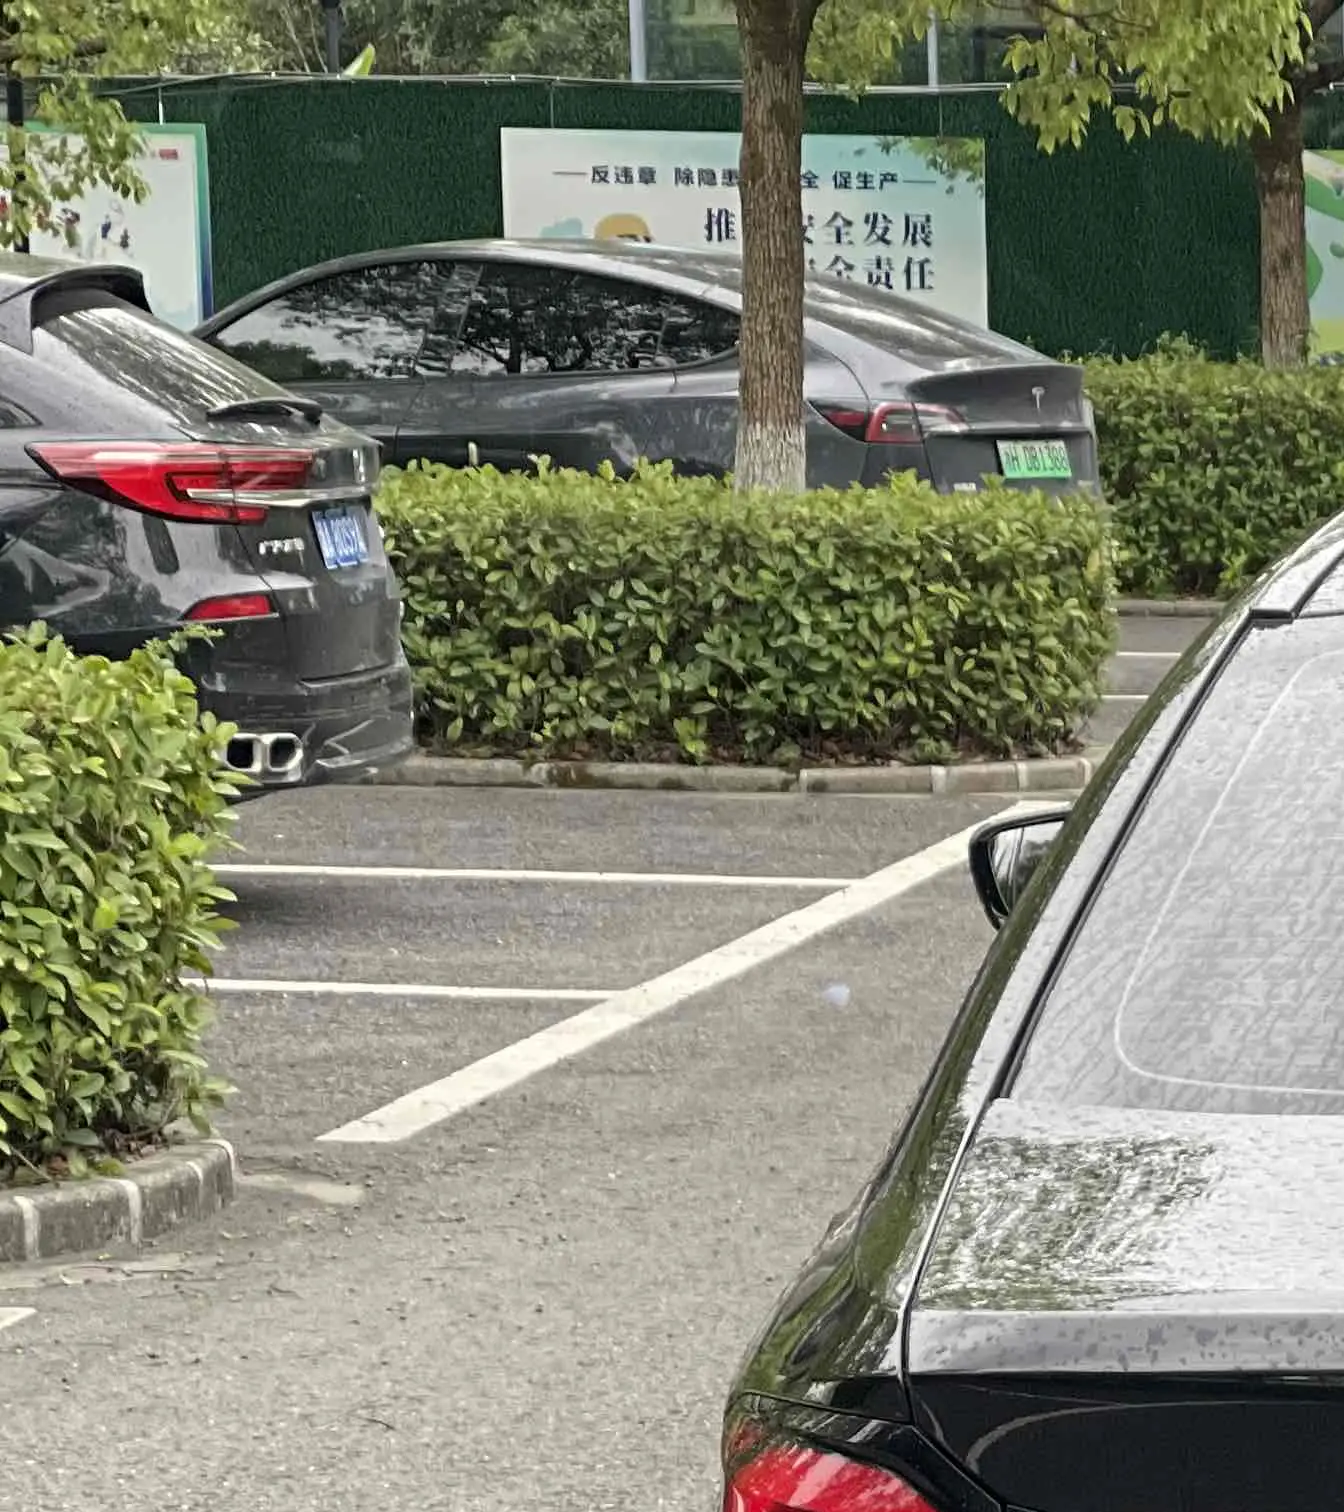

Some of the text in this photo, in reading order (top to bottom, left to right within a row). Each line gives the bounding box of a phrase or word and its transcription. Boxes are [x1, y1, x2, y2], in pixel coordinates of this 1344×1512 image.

[592, 165, 657, 185] 反违章
[832, 170, 898, 190] 促生产
[704, 208, 933, 248] 推全发展
